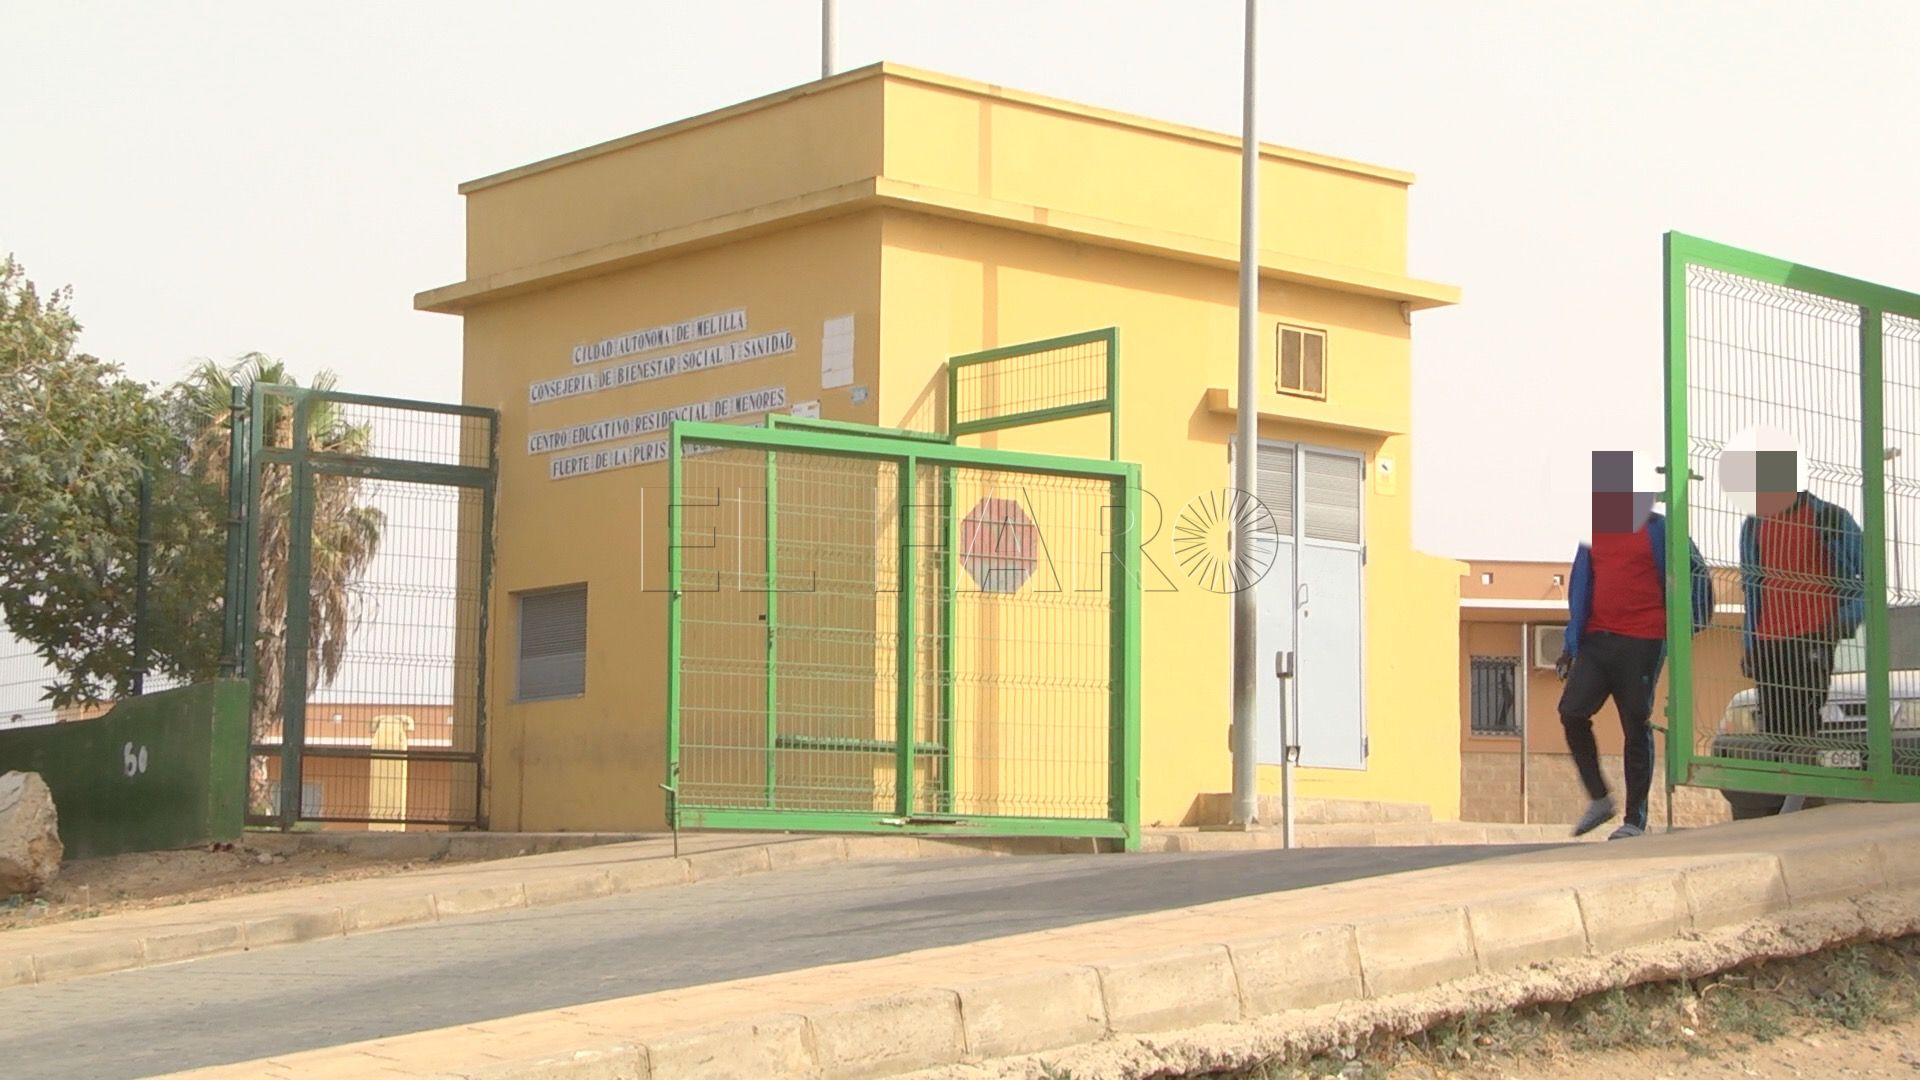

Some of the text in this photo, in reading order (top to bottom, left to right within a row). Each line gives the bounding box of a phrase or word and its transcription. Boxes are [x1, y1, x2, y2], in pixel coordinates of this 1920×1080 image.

[574, 313, 744, 363] CIUDAD AUTONOMA DE MELILLA
[531, 332, 793, 401] CONSEJERIA DE BIENESTAR SOCIAL Y SANIDAD
[530, 431, 567, 452] CENTRO
[572, 419, 630, 444] EDUCATIVO
[635, 405, 707, 432] RESIDENCIAL
[714, 400, 728, 417] DE
[735, 388, 785, 413] MENORES
[552, 455, 589, 477] FUERTE
[595, 453, 608, 470] DE
[614, 450, 627, 466] LA
[123, 741, 149, 777] 60
